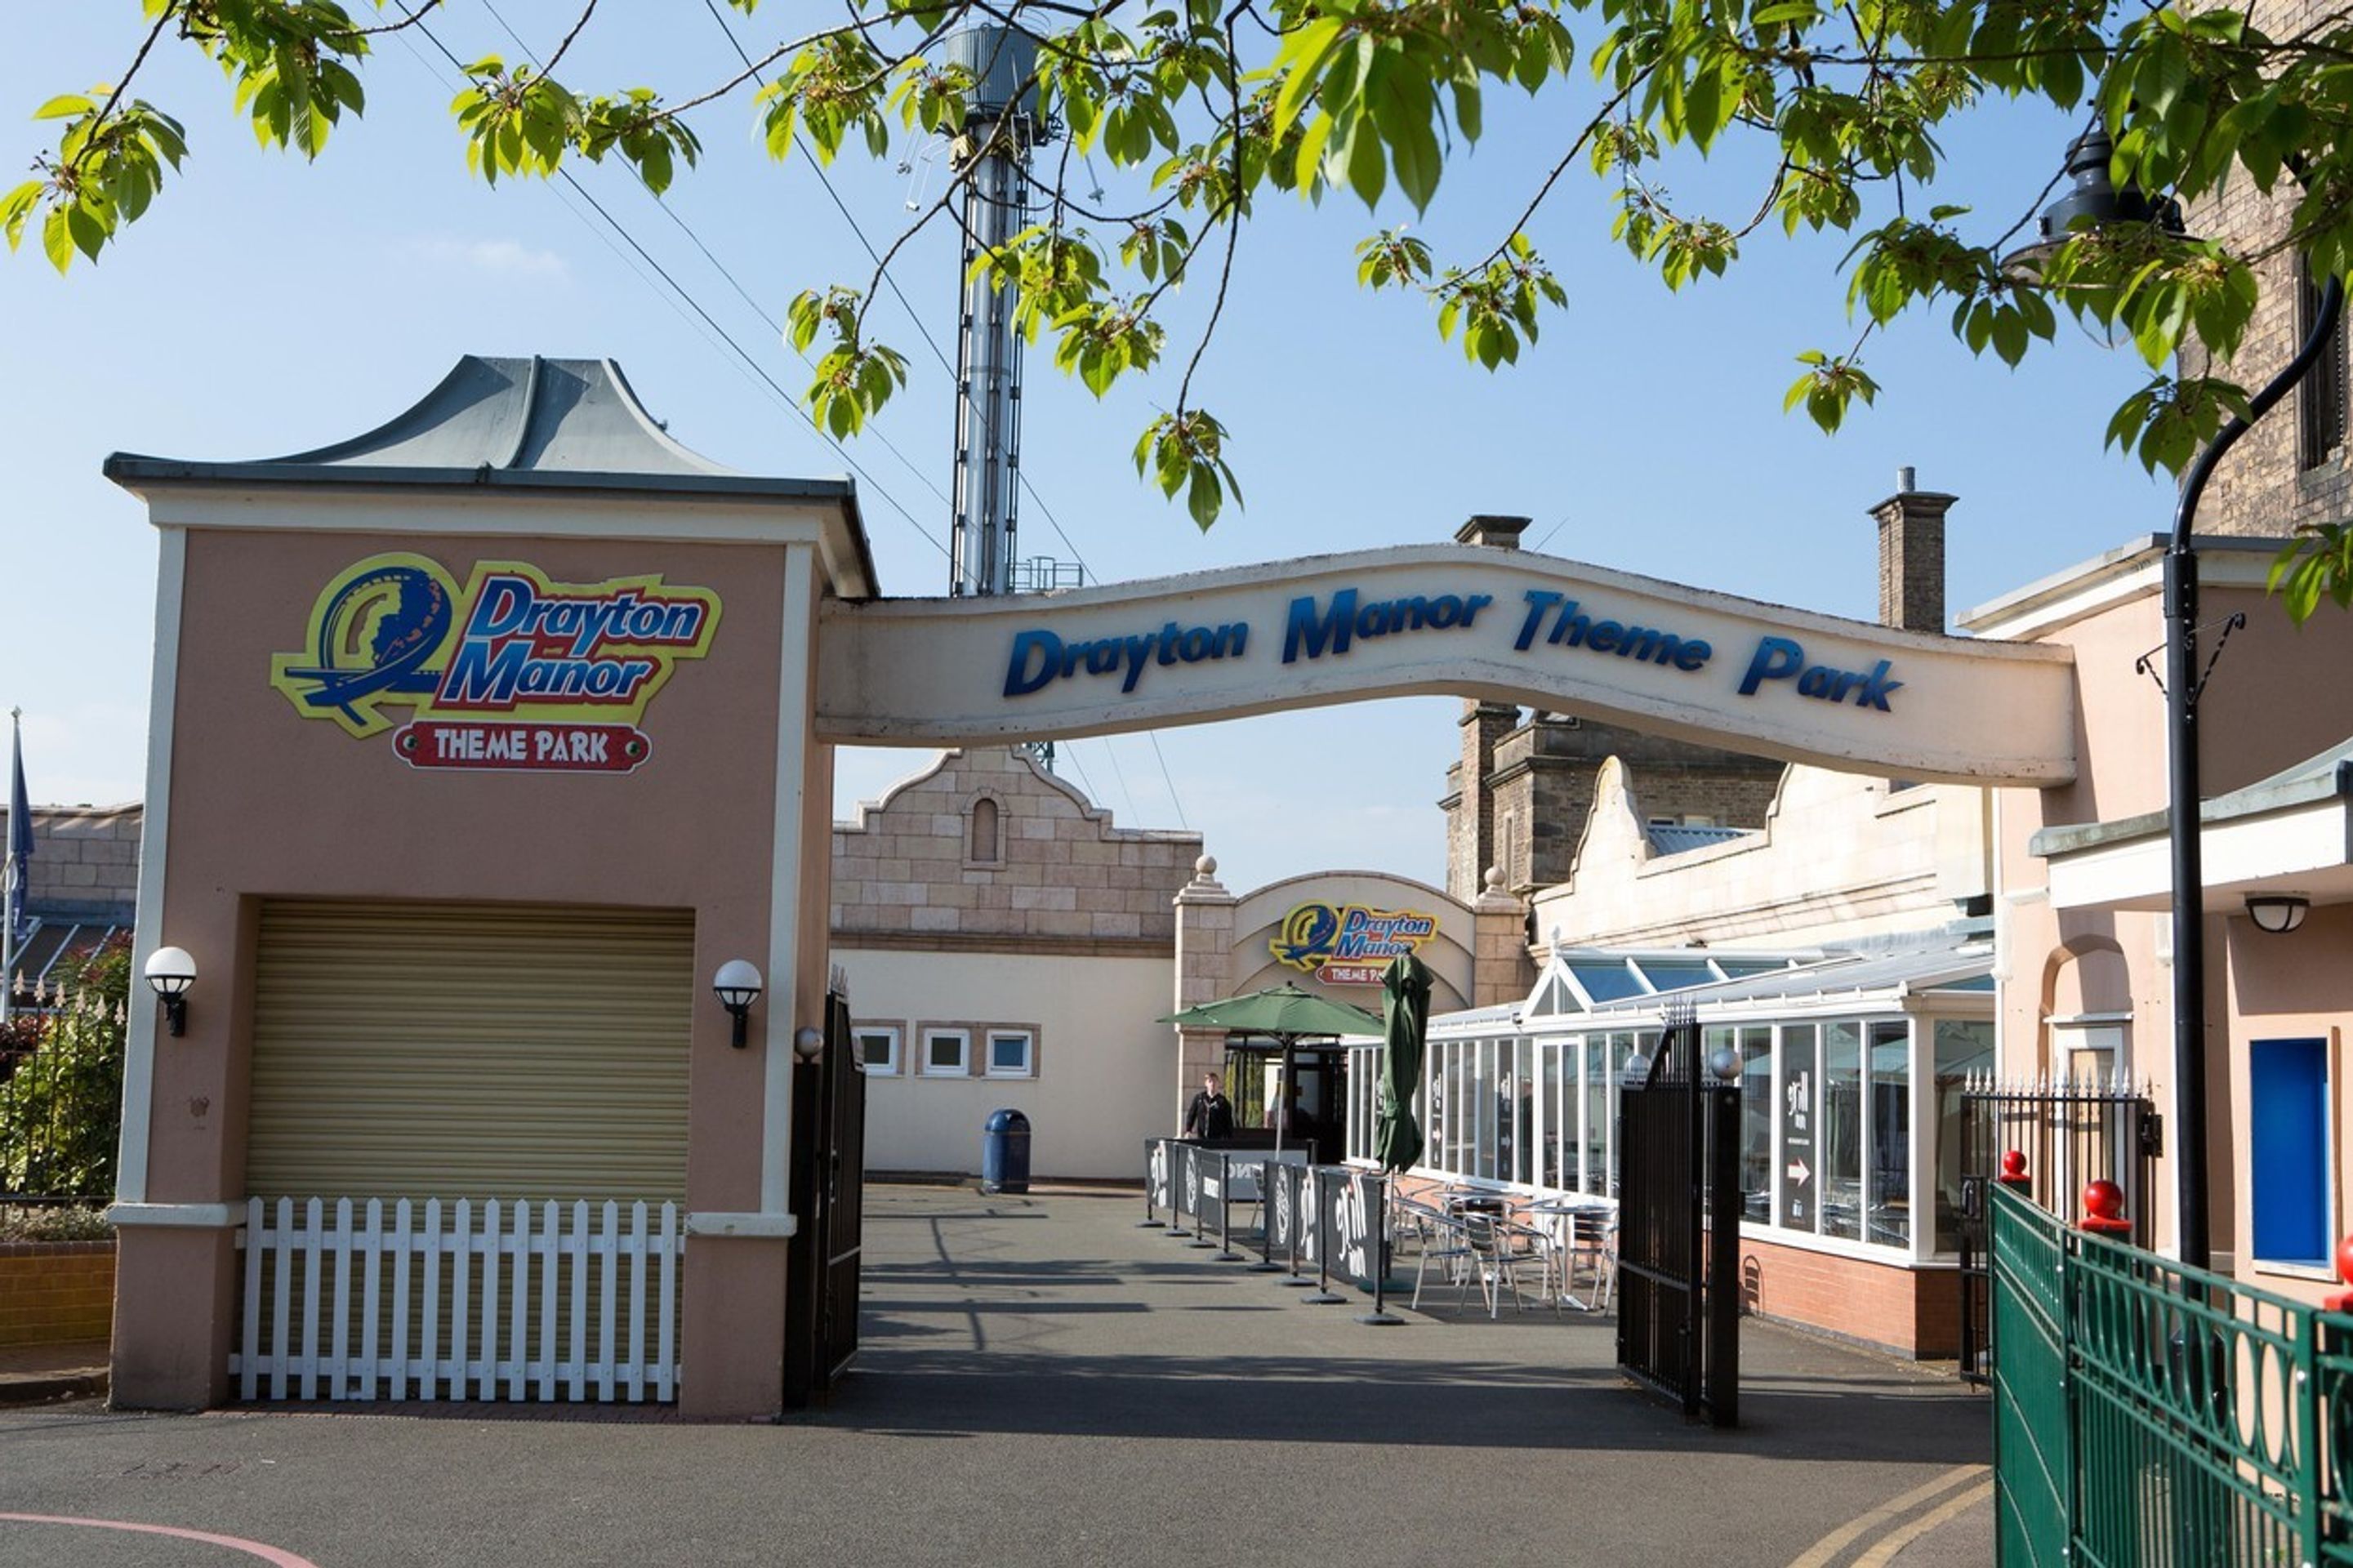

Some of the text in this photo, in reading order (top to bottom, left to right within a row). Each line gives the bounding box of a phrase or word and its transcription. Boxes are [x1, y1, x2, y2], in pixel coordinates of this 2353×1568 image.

[466, 575, 701, 656] Drayton
[442, 640, 653, 703] Manor
[1003, 587, 1905, 713] Drayton Manor Theme Park
[435, 728, 609, 764] THEME PARK
[1344, 910, 1430, 939] Drayton
[1331, 967, 1366, 981] THEME
[1335, 1174, 1367, 1262] grill
